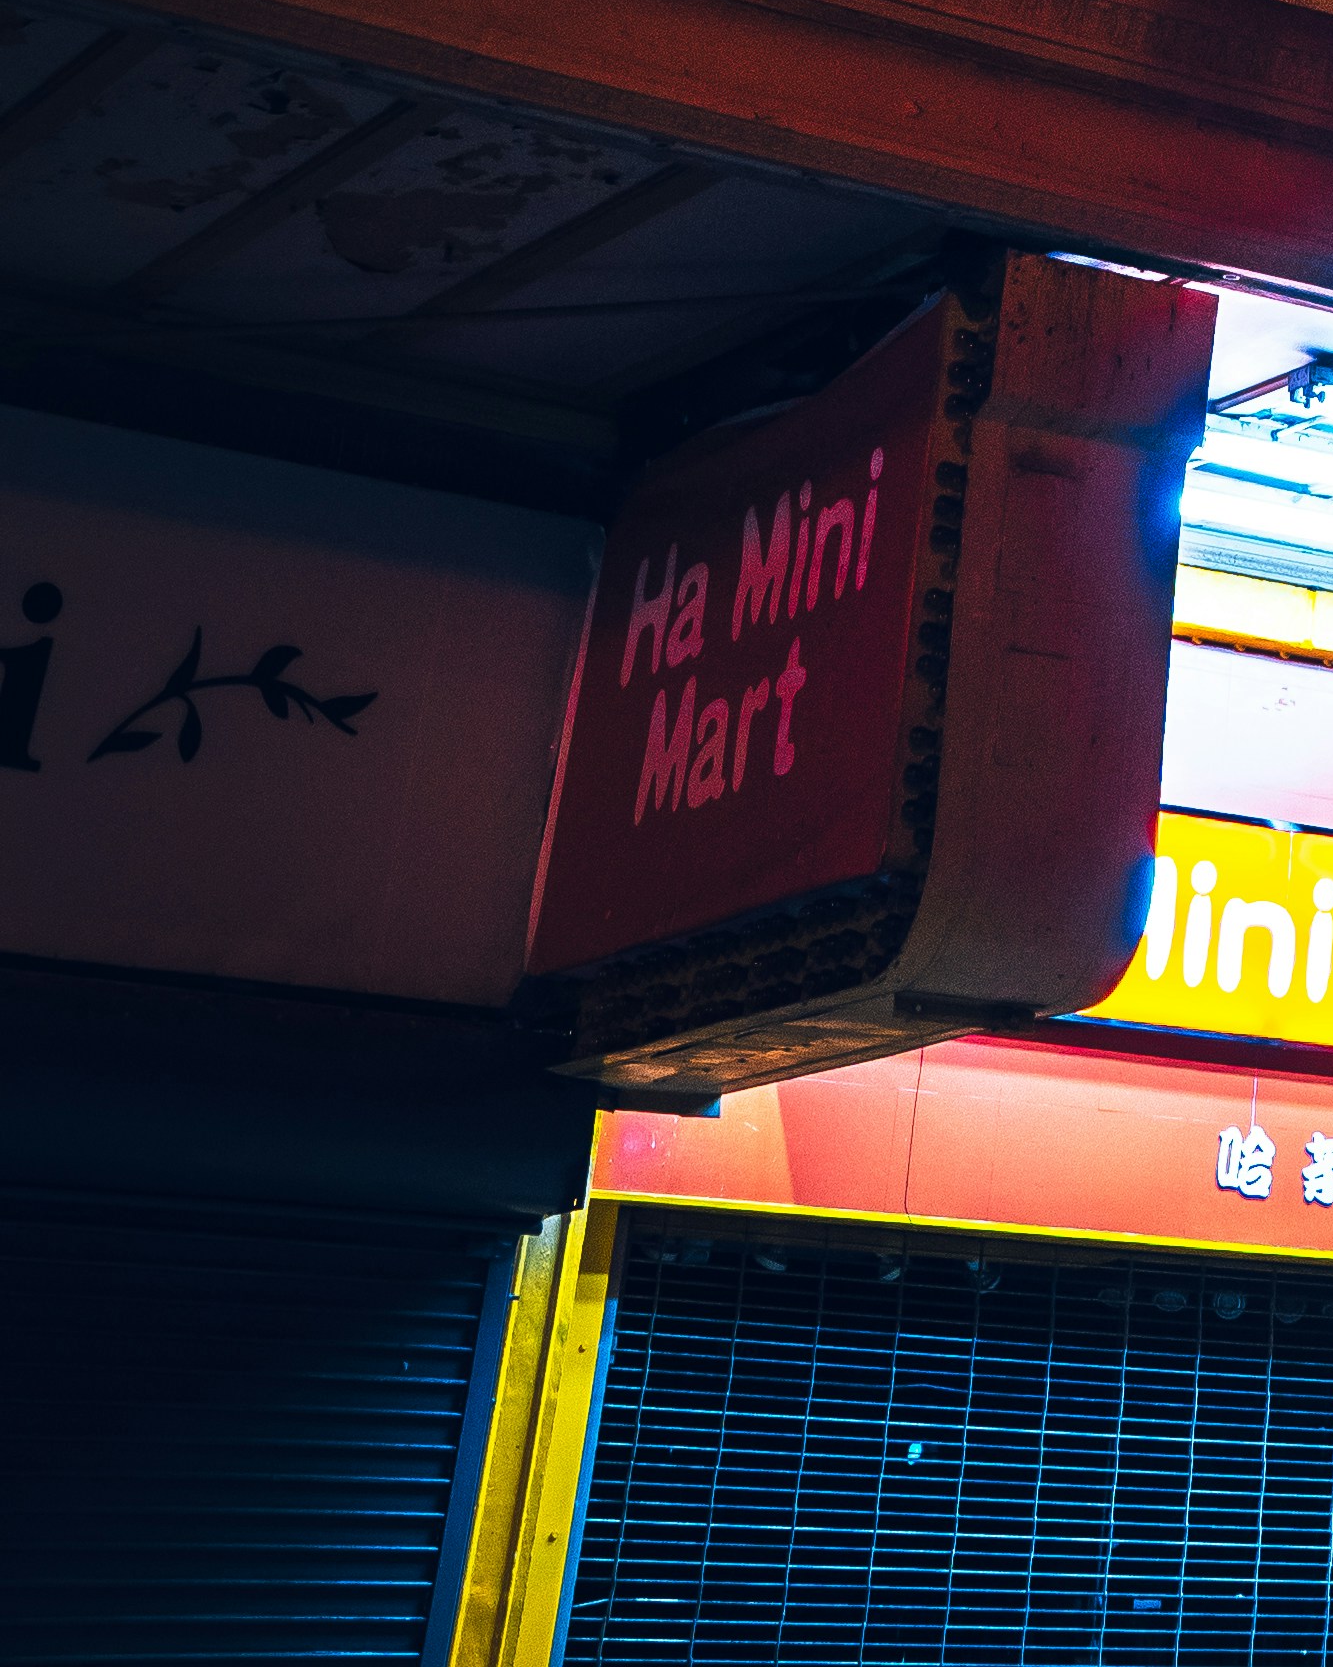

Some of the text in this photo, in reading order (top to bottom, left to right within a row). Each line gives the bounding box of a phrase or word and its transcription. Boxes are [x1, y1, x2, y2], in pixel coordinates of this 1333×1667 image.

[619, 446, 885, 689] Ha Mini
[634, 637, 807, 825] Mart
